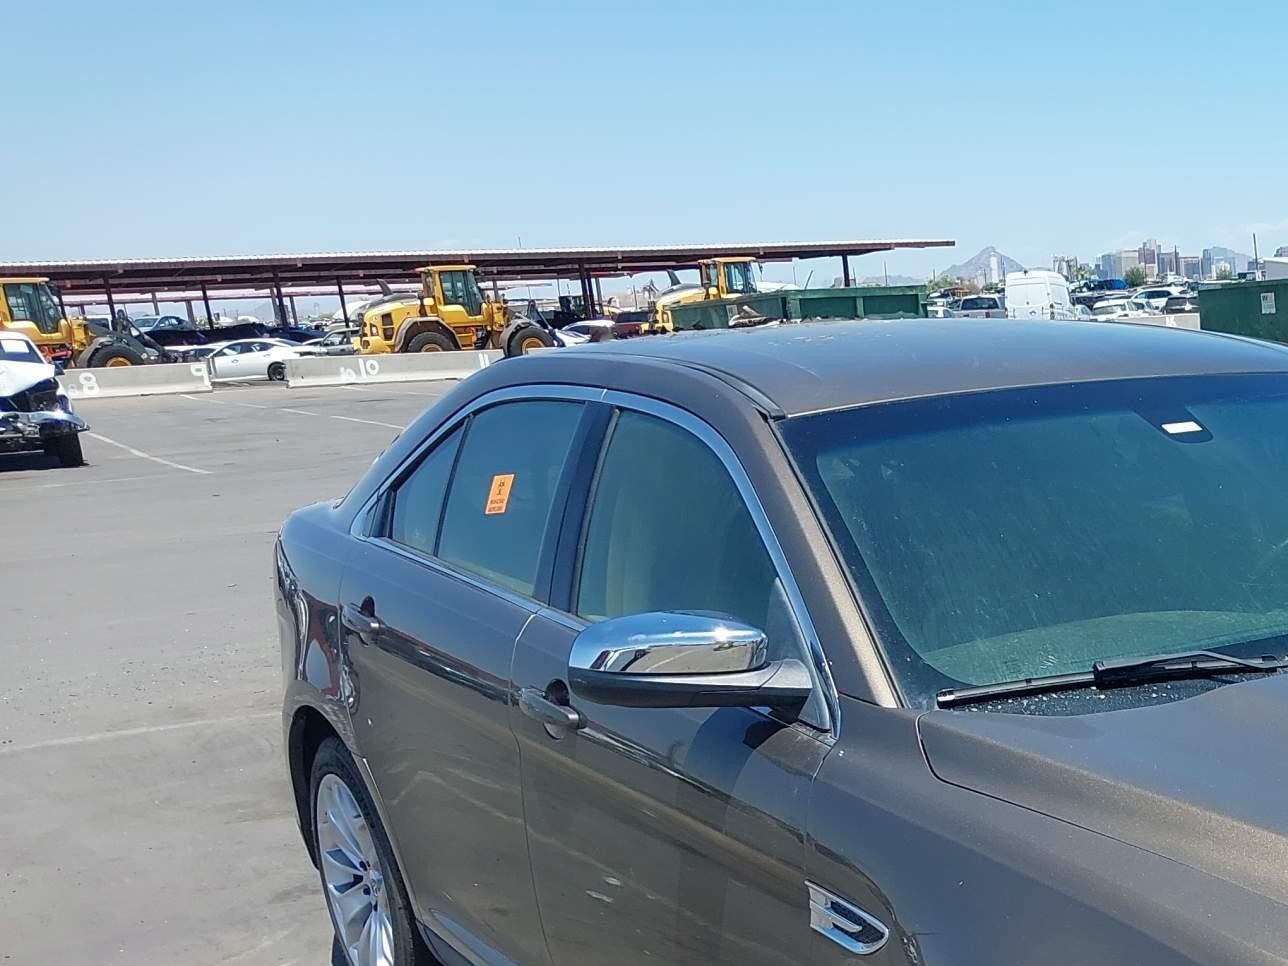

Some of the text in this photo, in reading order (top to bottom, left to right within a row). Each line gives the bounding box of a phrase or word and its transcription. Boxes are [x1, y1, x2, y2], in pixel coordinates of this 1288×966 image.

[190, 364, 210, 386] 9
[358, 358, 380, 379] 10
[79, 372, 100, 396] 8
